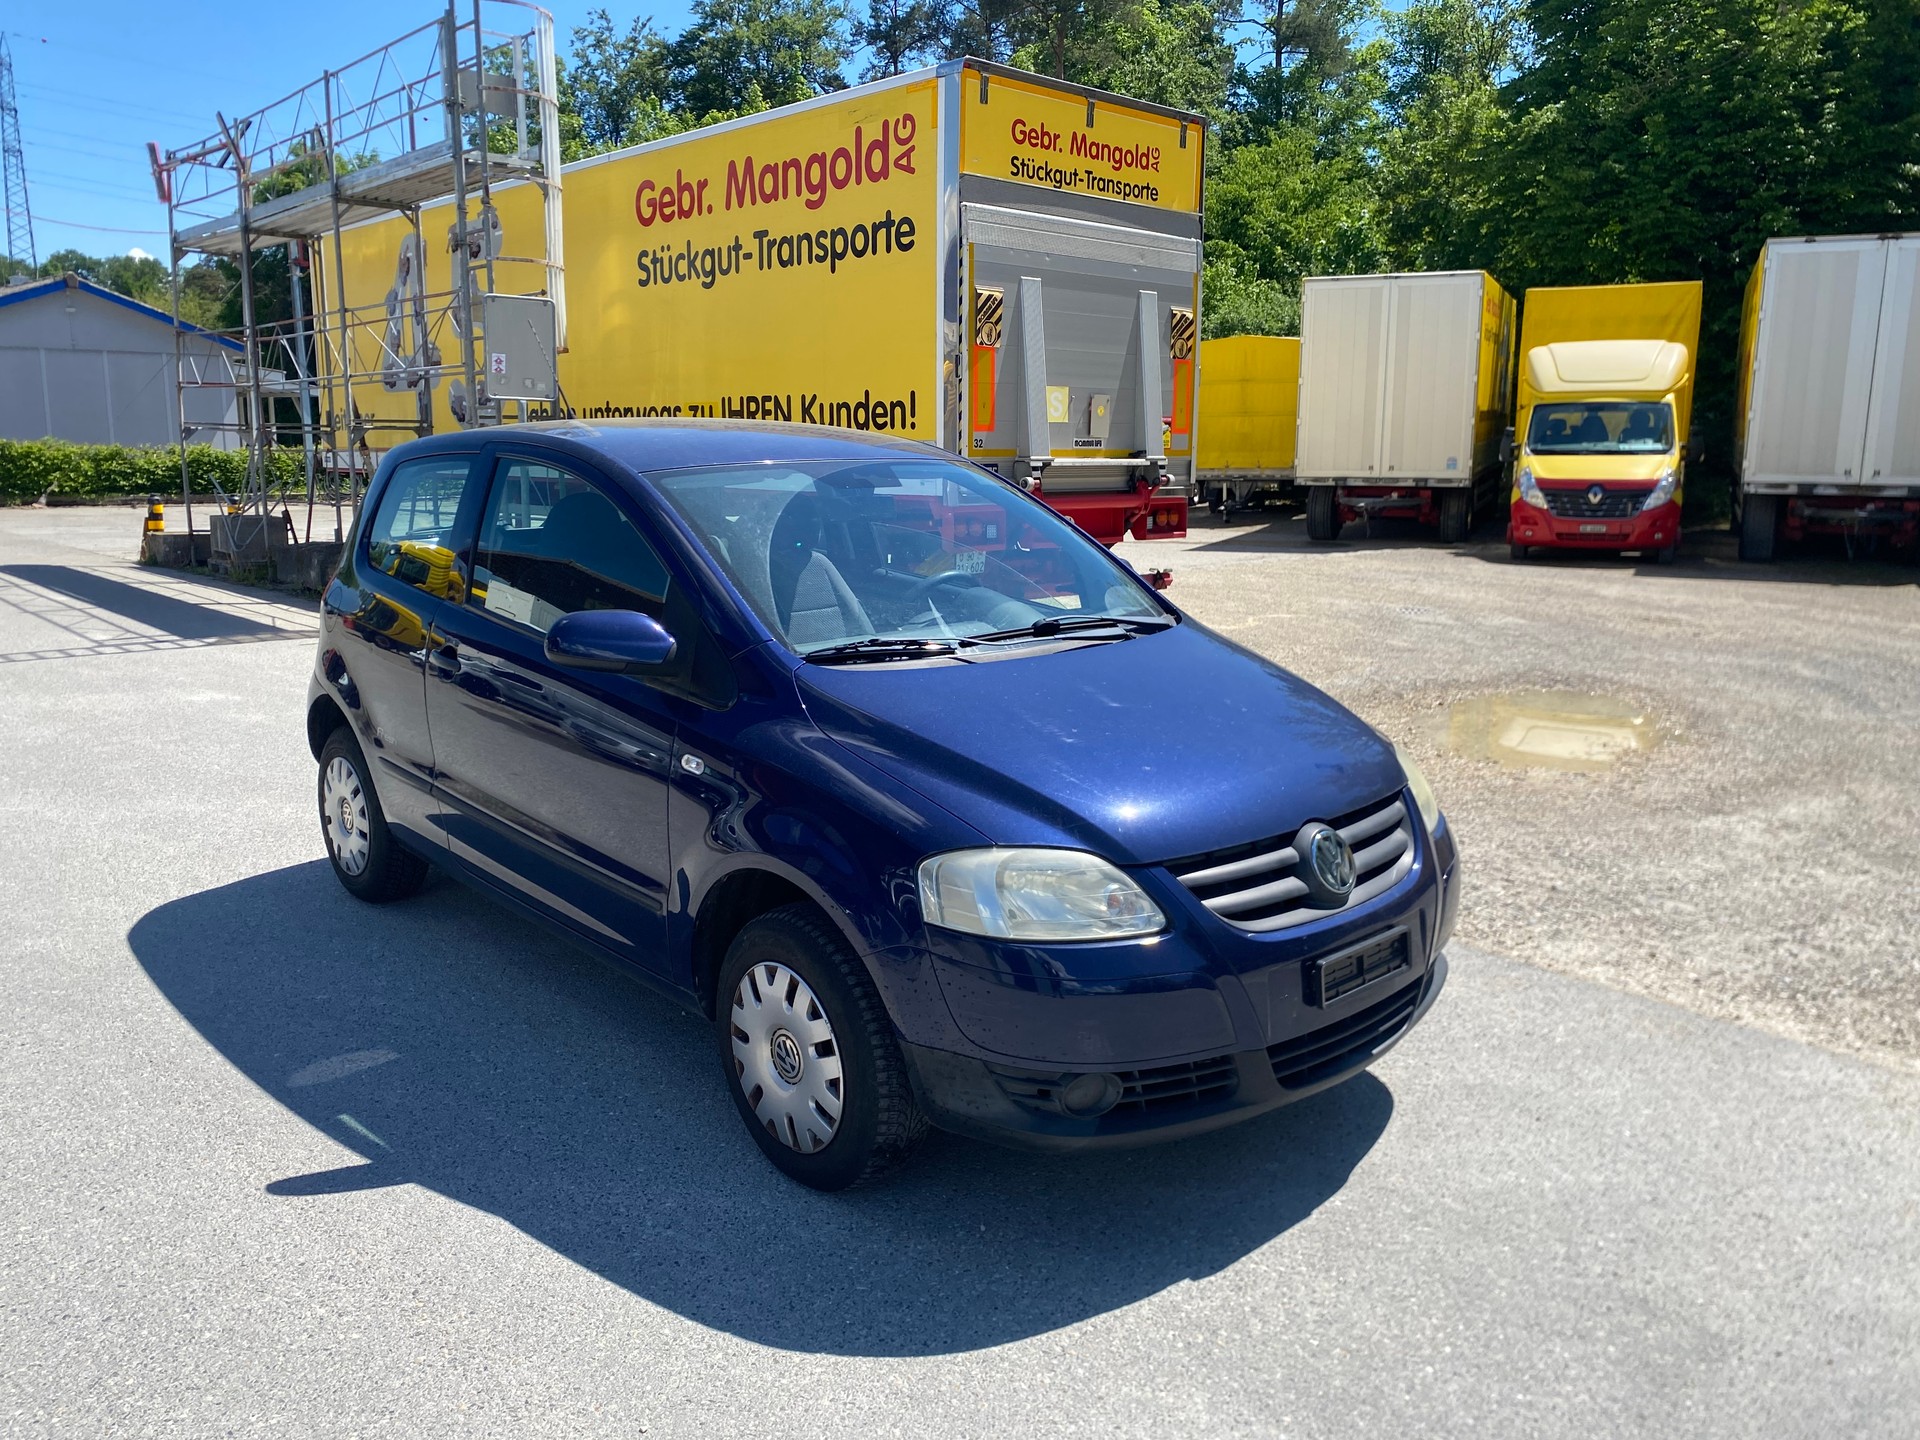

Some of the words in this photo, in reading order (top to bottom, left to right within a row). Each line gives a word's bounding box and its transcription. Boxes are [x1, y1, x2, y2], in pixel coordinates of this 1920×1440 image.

[635, 168, 713, 228] Gebr.
[725, 118, 890, 210] Mangold
[893, 113, 917, 175] AG
[1011, 118, 1063, 154] Gebr.
[1069, 130, 1151, 172] Mangold
[1151, 146, 1161, 173] AG
[1010, 156, 1158, 201] Stückgut-Transporte
[636, 209, 916, 290] Stückgut-Transporte
[801, 389, 916, 431] Kunden!
[973, 438, 984, 449] 32
